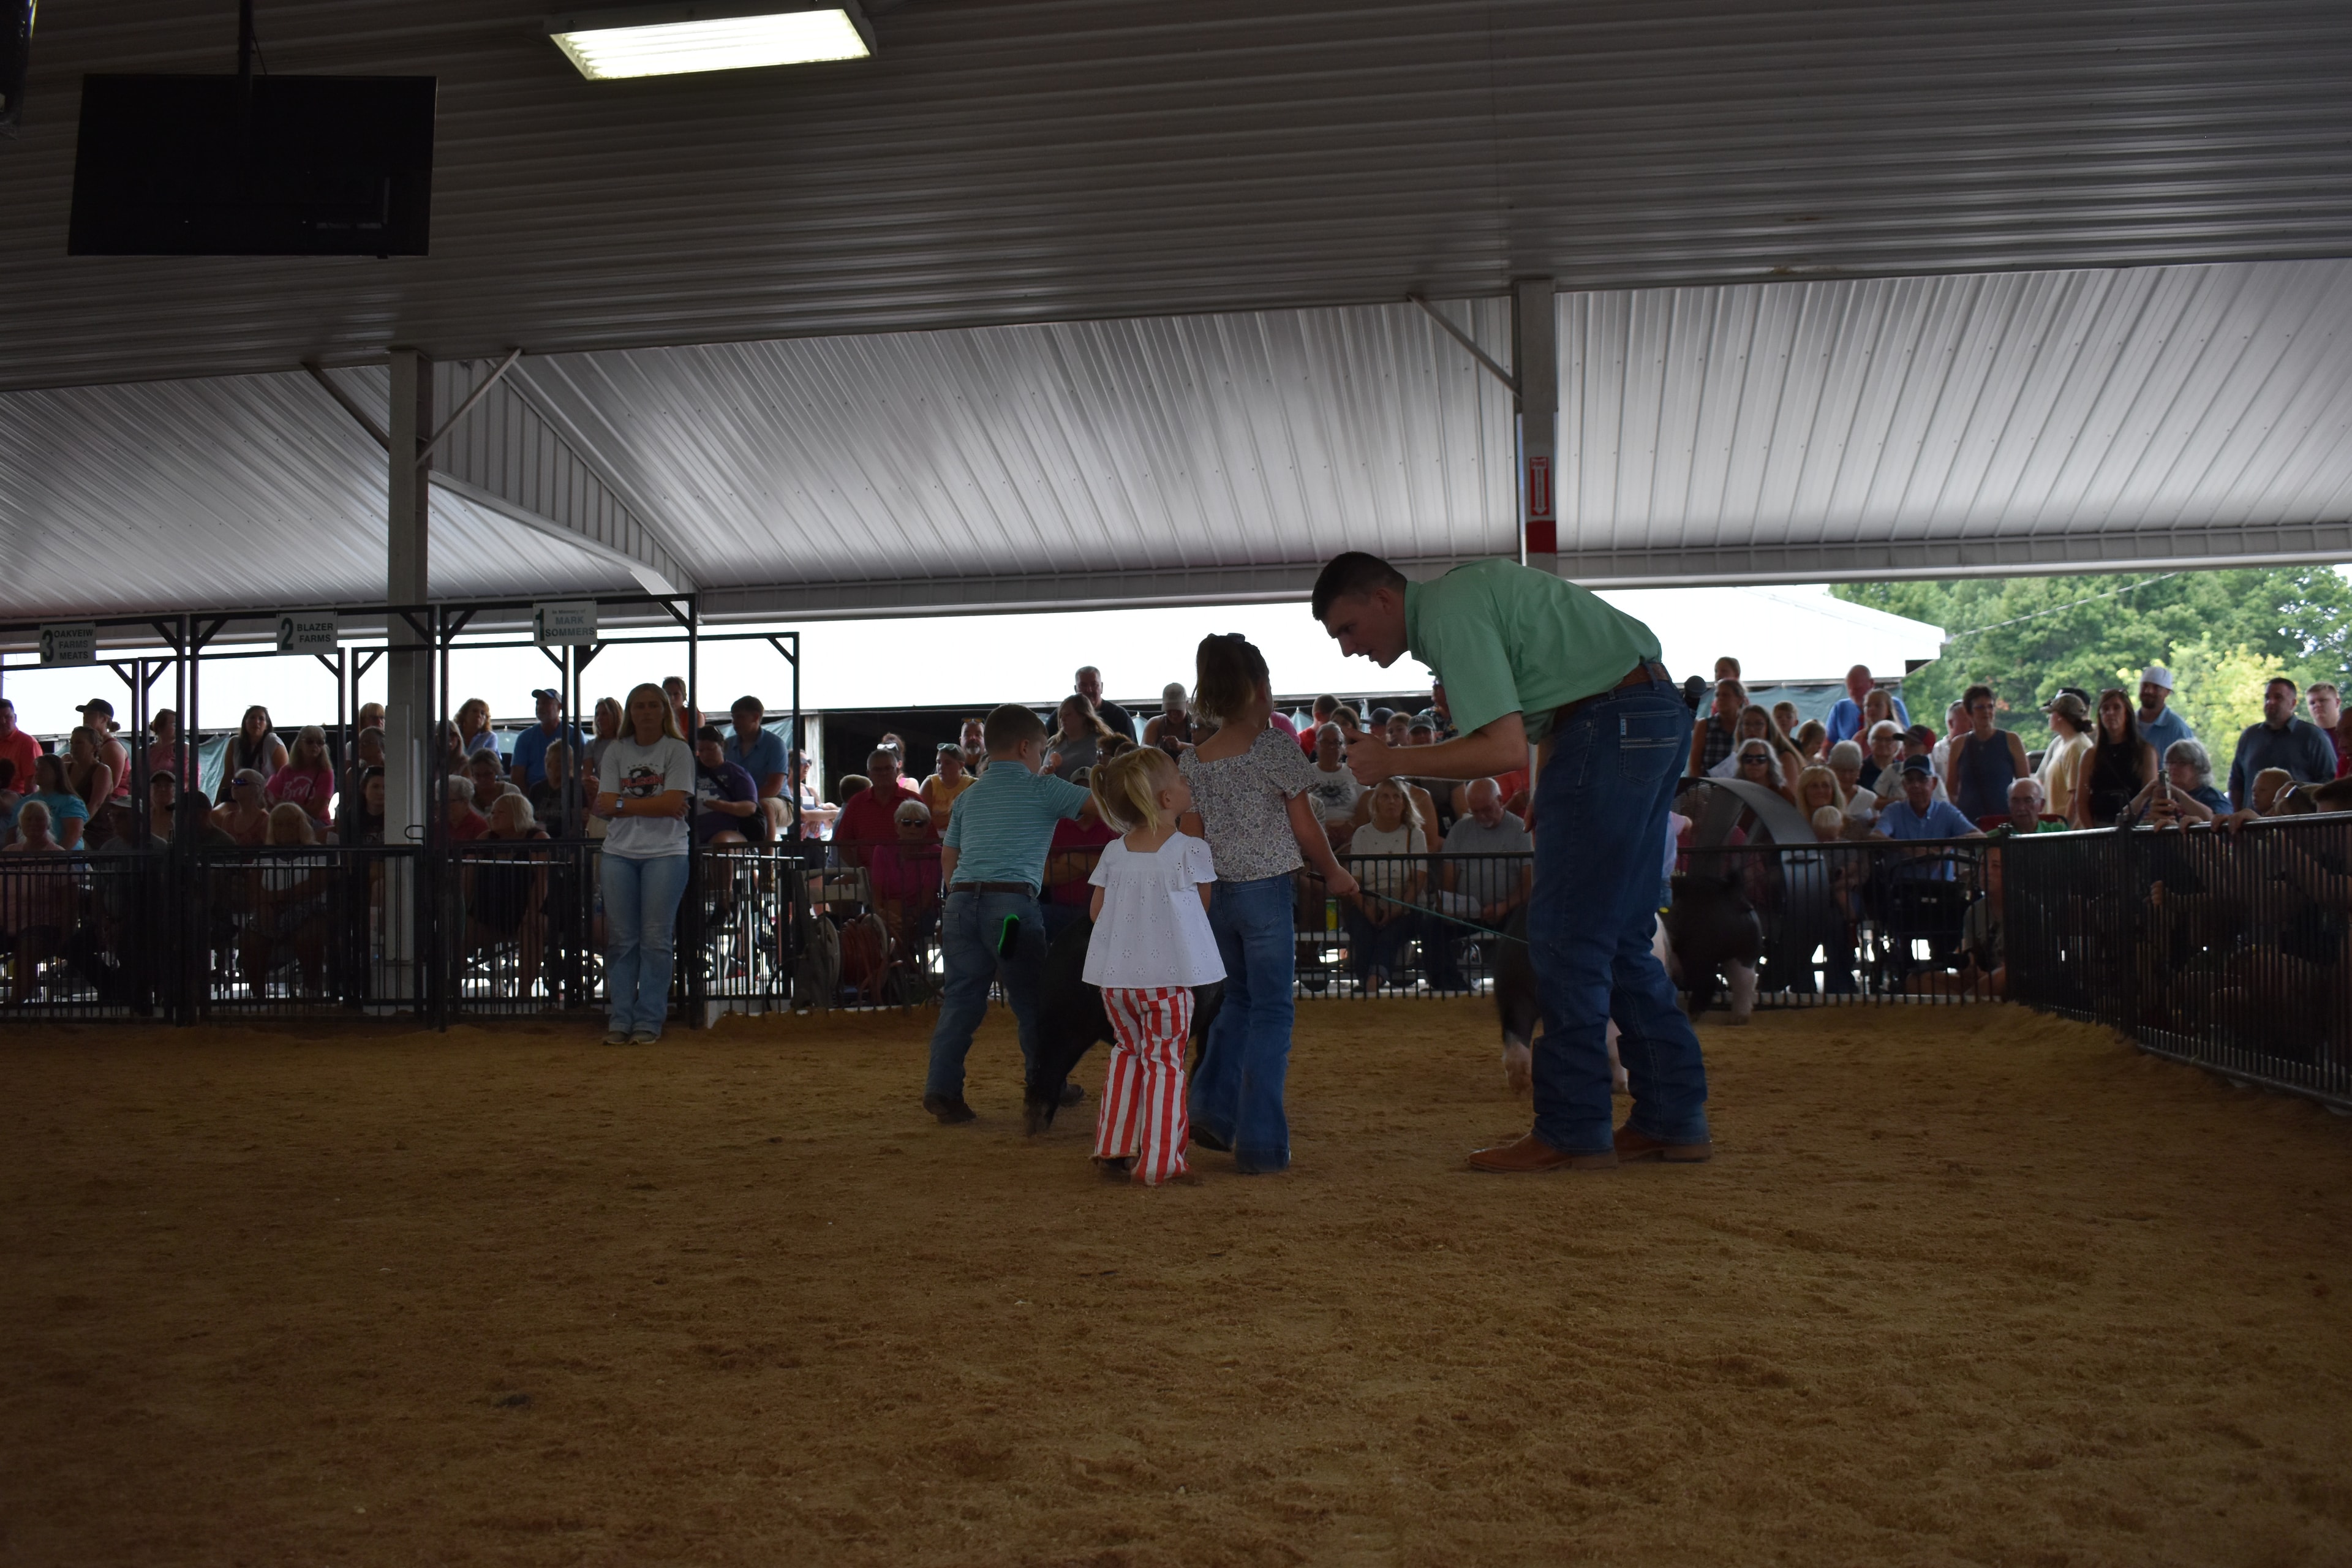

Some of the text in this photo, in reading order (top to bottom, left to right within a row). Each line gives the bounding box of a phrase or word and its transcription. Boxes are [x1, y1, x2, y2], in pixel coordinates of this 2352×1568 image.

[535, 608, 545, 641] 1
[556, 616, 584, 625] MARK
[297, 623, 333, 631] BLAZER
[545, 627, 595, 637] SOMMERS
[54, 629, 93, 638] OAKVEIW
[281, 617, 293, 650] 2
[42, 630, 54, 663] 3
